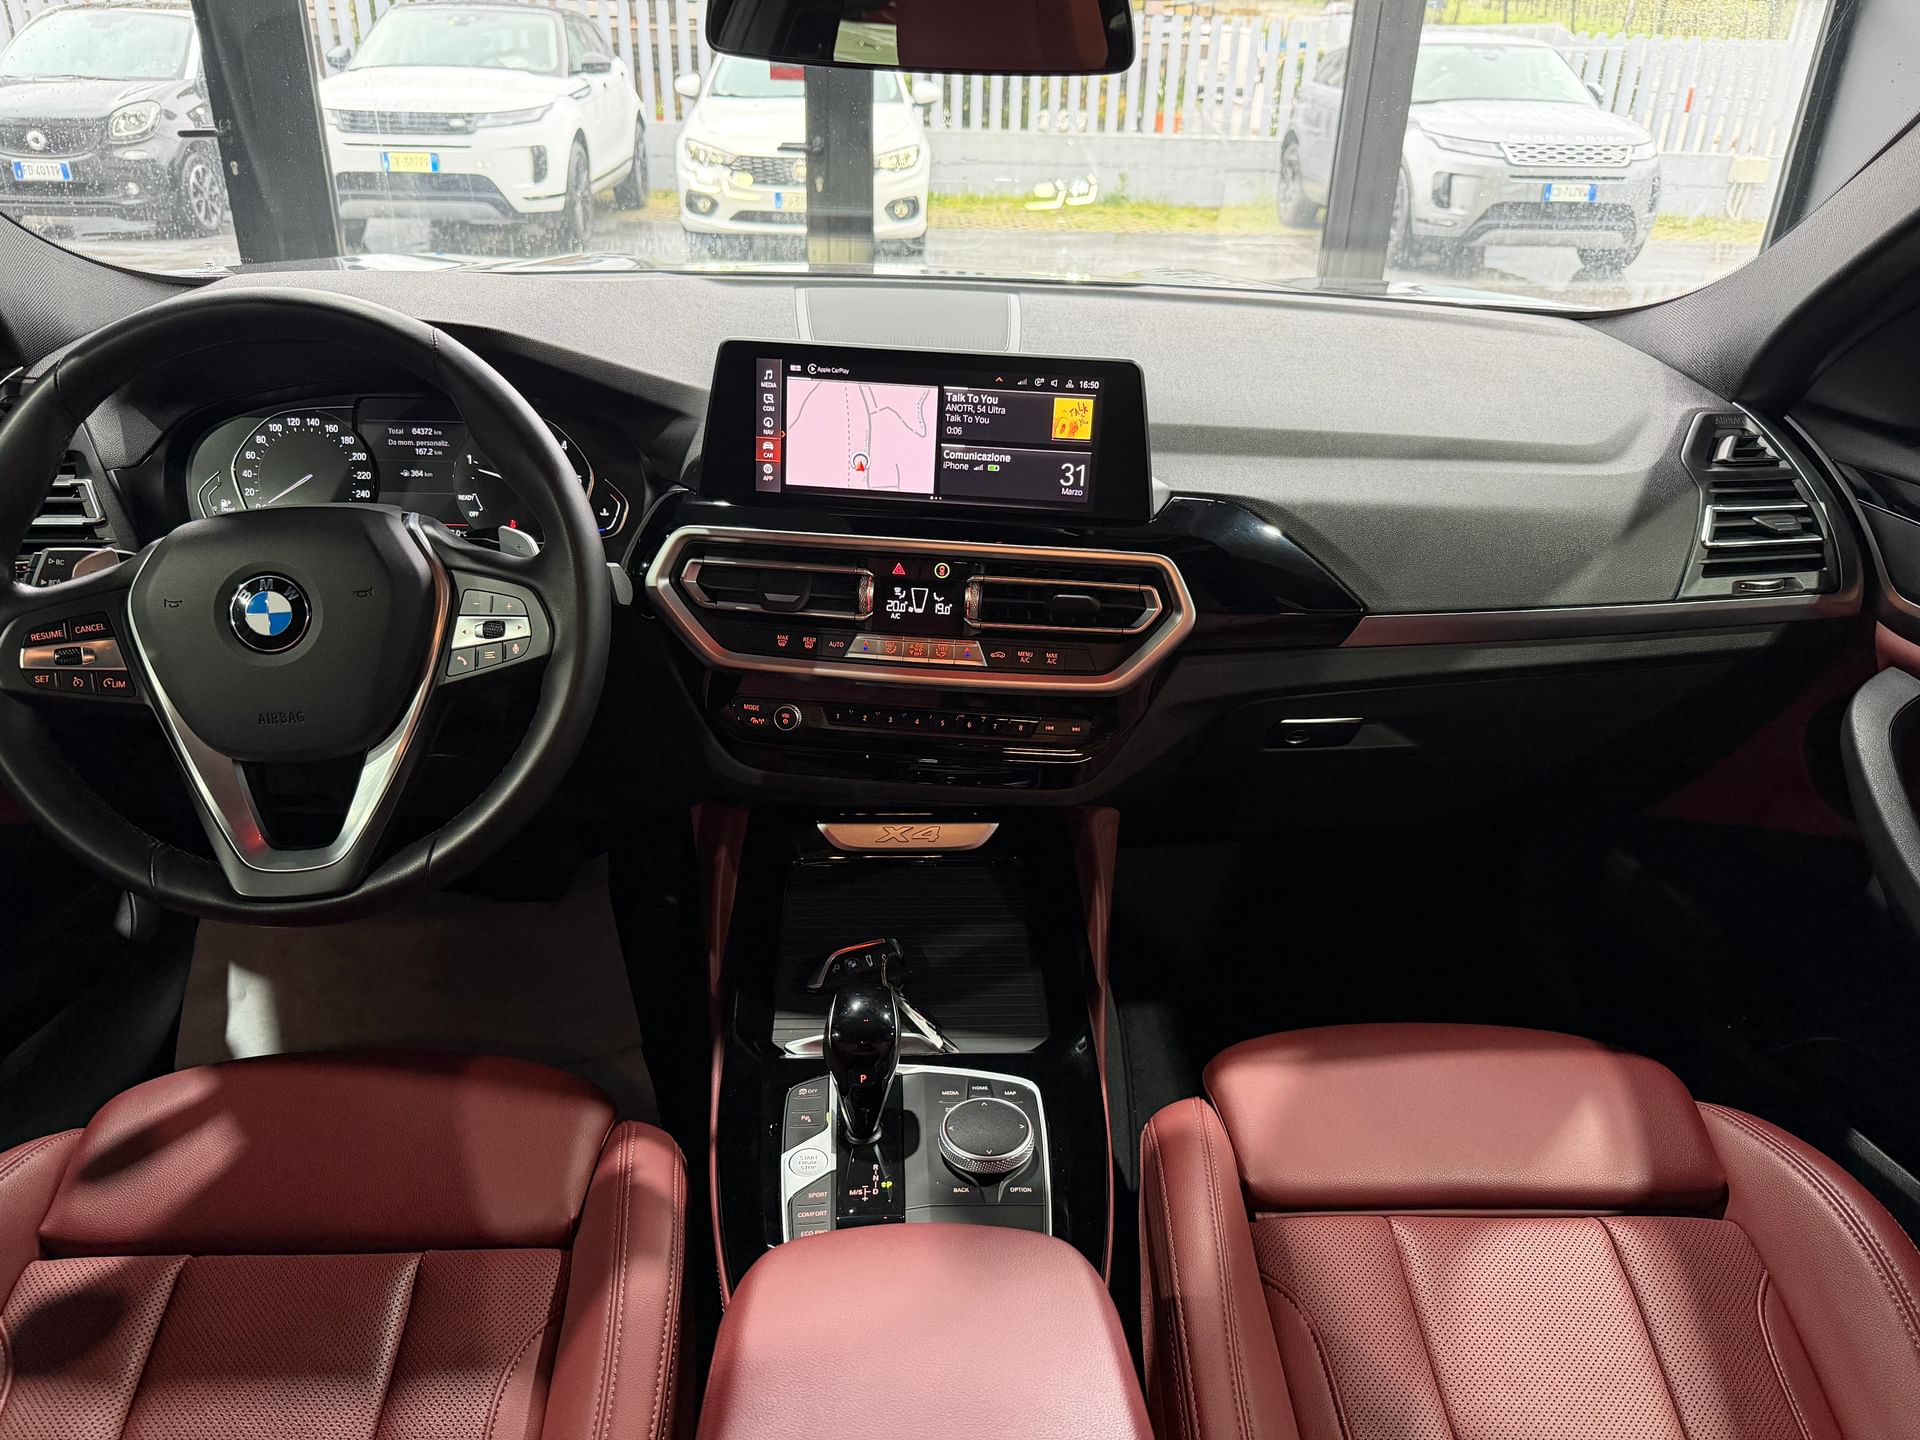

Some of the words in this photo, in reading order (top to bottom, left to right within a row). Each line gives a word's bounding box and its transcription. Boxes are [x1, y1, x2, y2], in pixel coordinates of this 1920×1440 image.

[831, 367, 850, 375] CarPlay
[760, 381, 777, 389] MEDIA
[1079, 380, 1100, 389] 16:50
[946, 392, 966, 404] Talk
[968, 393, 979, 404] To
[980, 395, 999, 405] You
[945, 403, 976, 414] ANOTR,
[976, 405, 987, 414] 54
[988, 405, 1006, 415] Ultra
[287, 418, 300, 426] 120
[306, 418, 320, 427] 140
[945, 413, 962, 422] Talk
[963, 415, 973, 423] To
[974, 415, 990, 425] You
[268, 424, 283, 432] 100
[324, 425, 339, 433] 160
[411, 427, 433, 436] 64372
[946, 426, 963, 436] 0:06
[256, 436, 267, 444] 80
[340, 436, 355, 445] 180
[561, 440, 568, 451] 4
[245, 451, 256, 460] 60
[352, 452, 367, 461] 200
[415, 448, 433, 456] 167.2
[943, 450, 1011, 463] Comunicazione
[943, 462, 969, 471] iPhone
[242, 470, 253, 478] 40
[356, 471, 372, 480] 220
[1059, 462, 1086, 487] 31
[244, 487, 255, 496] 20
[355, 490, 371, 498] 240
[1061, 487, 1083, 497] Marzo
[238, 579, 300, 603] BMW
[74, 623, 107, 634] CANCEL
[30, 629, 64, 642] RESUME
[34, 675, 50, 683] SET
[112, 680, 126, 688] LIM
[743, 703, 760, 711] MODE
[258, 712, 305, 724] AIRBAG
[875, 826, 940, 842] X4
[860, 1074, 867, 1084] P
[953, 1186, 970, 1194] BACK
[1009, 1186, 1033, 1194] OPTION
